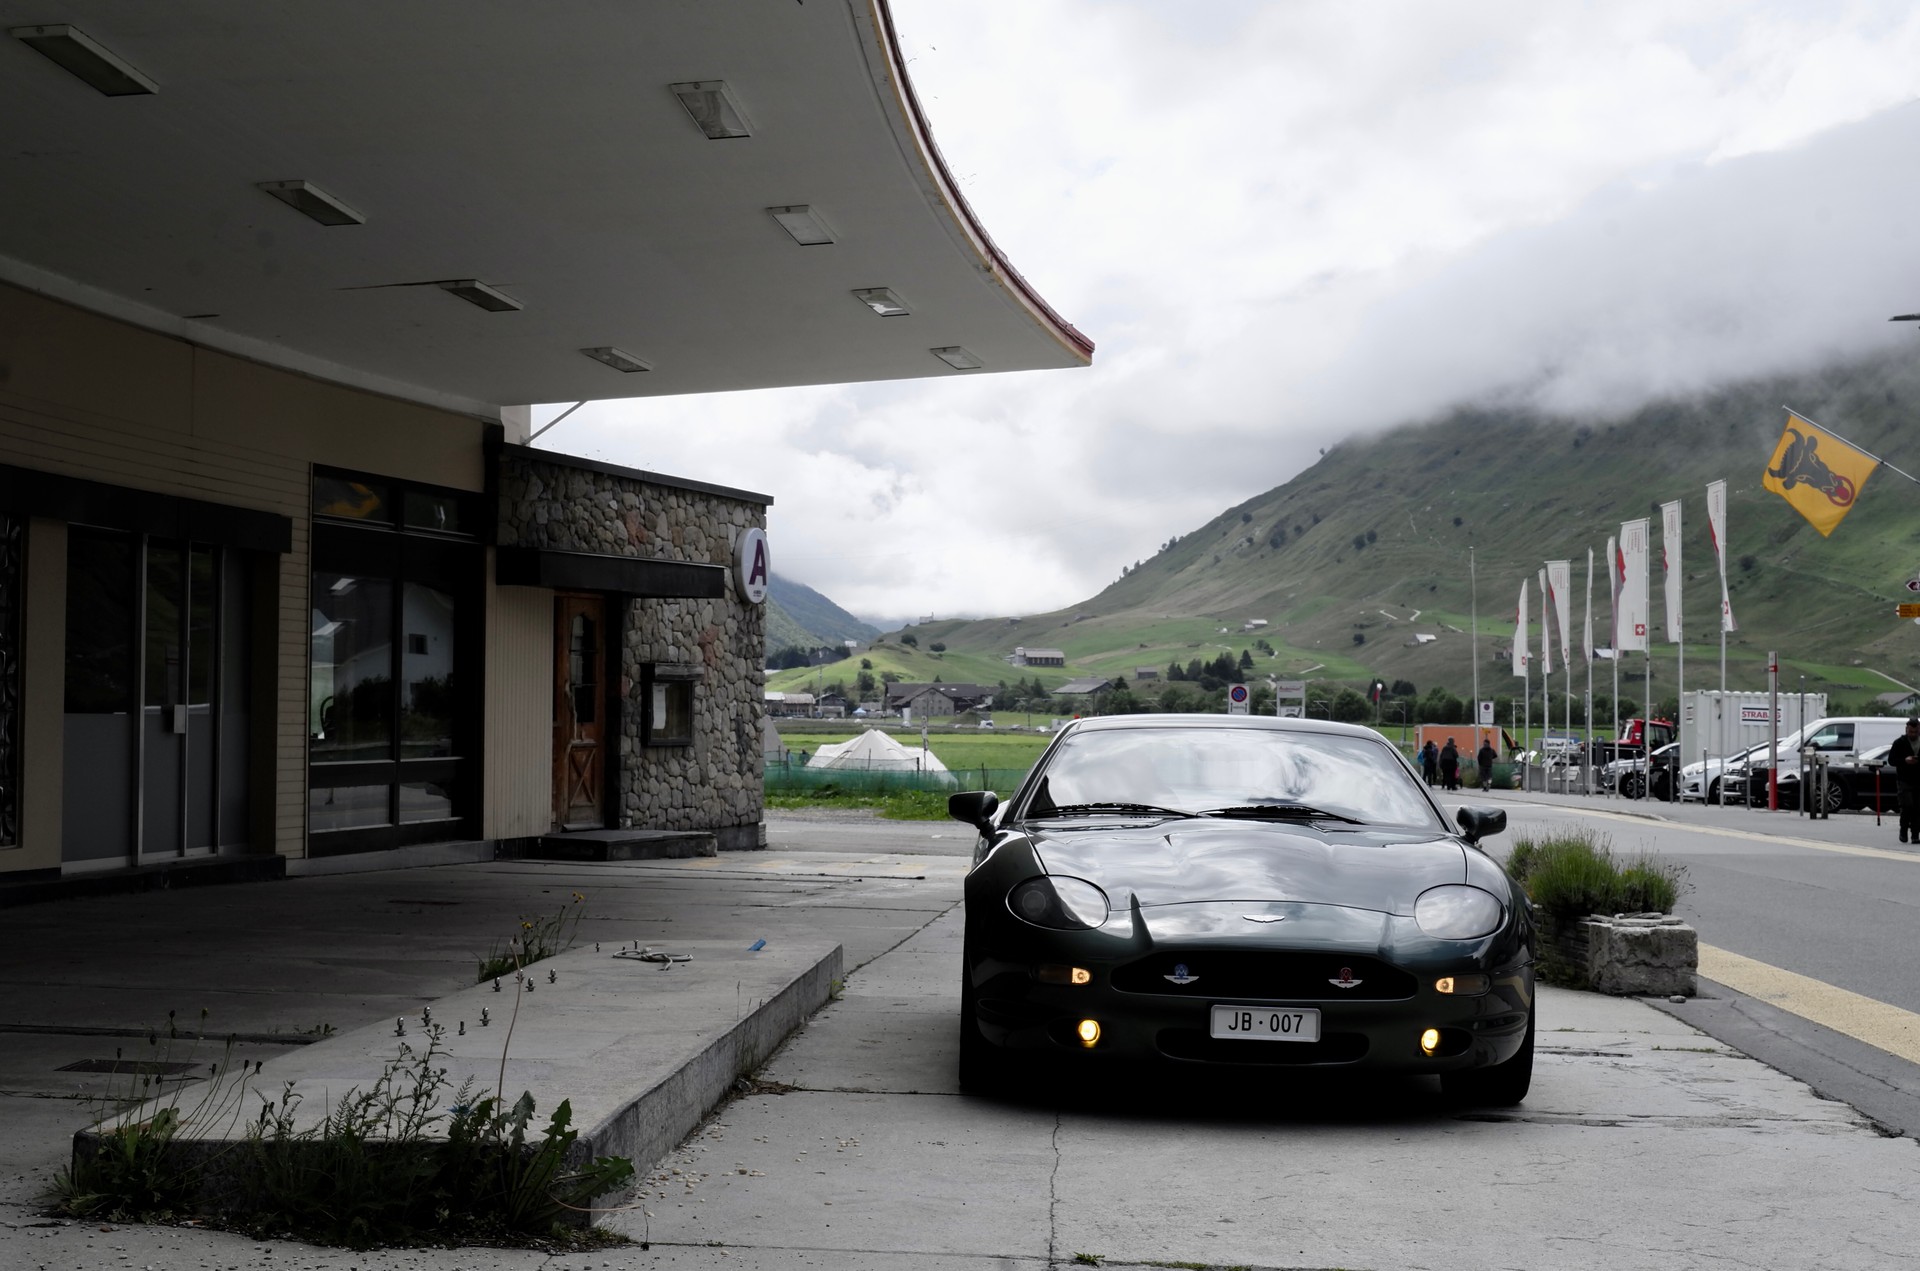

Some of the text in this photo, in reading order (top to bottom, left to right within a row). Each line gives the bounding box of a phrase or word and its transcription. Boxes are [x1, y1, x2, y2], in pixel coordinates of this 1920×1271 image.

[749, 539, 767, 586] A
[1742, 711, 1781, 719] STRABG
[1270, 1014, 1303, 1033] 007
